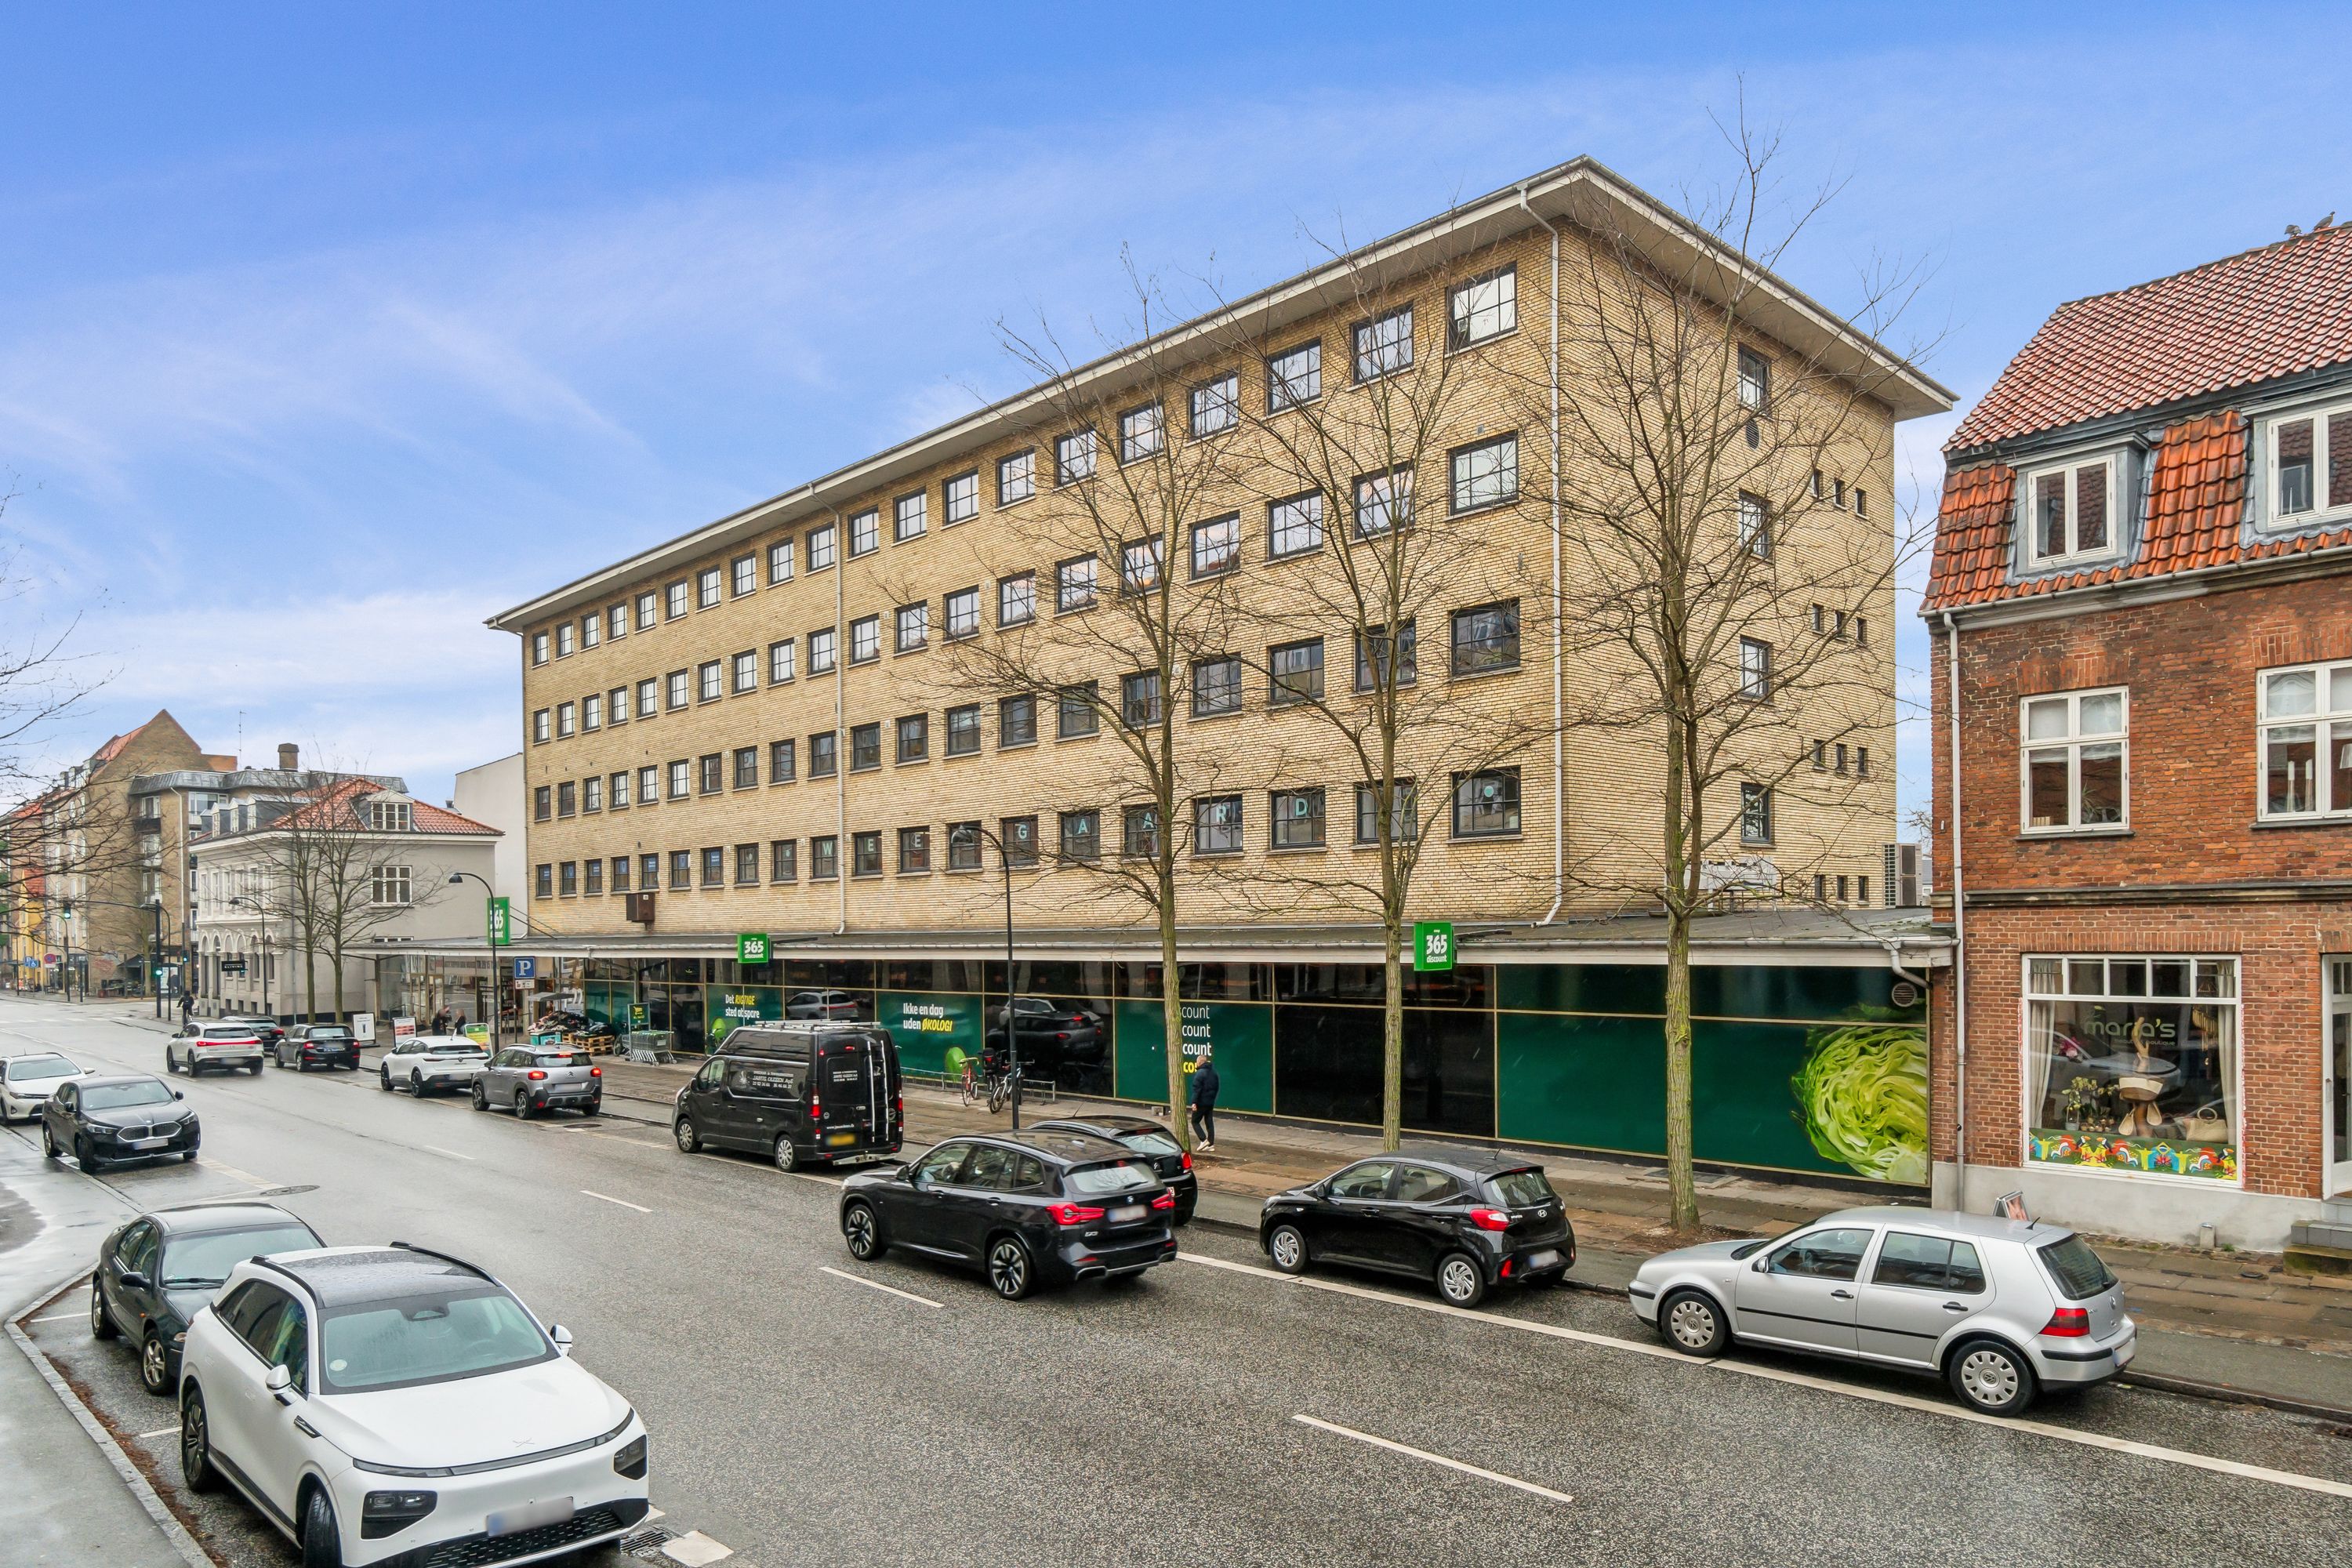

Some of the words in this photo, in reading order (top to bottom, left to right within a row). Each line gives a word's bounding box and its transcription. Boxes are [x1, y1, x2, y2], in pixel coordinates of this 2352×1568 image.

[868, 839, 874, 851] E
[914, 834, 921, 848] E
[1078, 818, 1087, 834] A
[1143, 812, 1154, 829] A
[1217, 805, 1226, 822] R
[1295, 798, 1307, 816] D
[744, 941, 764, 953] 365
[1426, 935, 1447, 954] 365
[518, 960, 531, 975] P
[725, 994, 735, 1004] Det
[735, 994, 755, 1005] RIGTIGE
[726, 1007, 736, 1017] sted
[745, 1010, 760, 1020] spare
[903, 1003, 918, 1014] Ikke
[920, 1006, 927, 1014] en
[929, 1004, 943, 1018] dag
[903, 1018, 921, 1029] uden
[922, 1018, 953, 1031] ØKOLOGI
